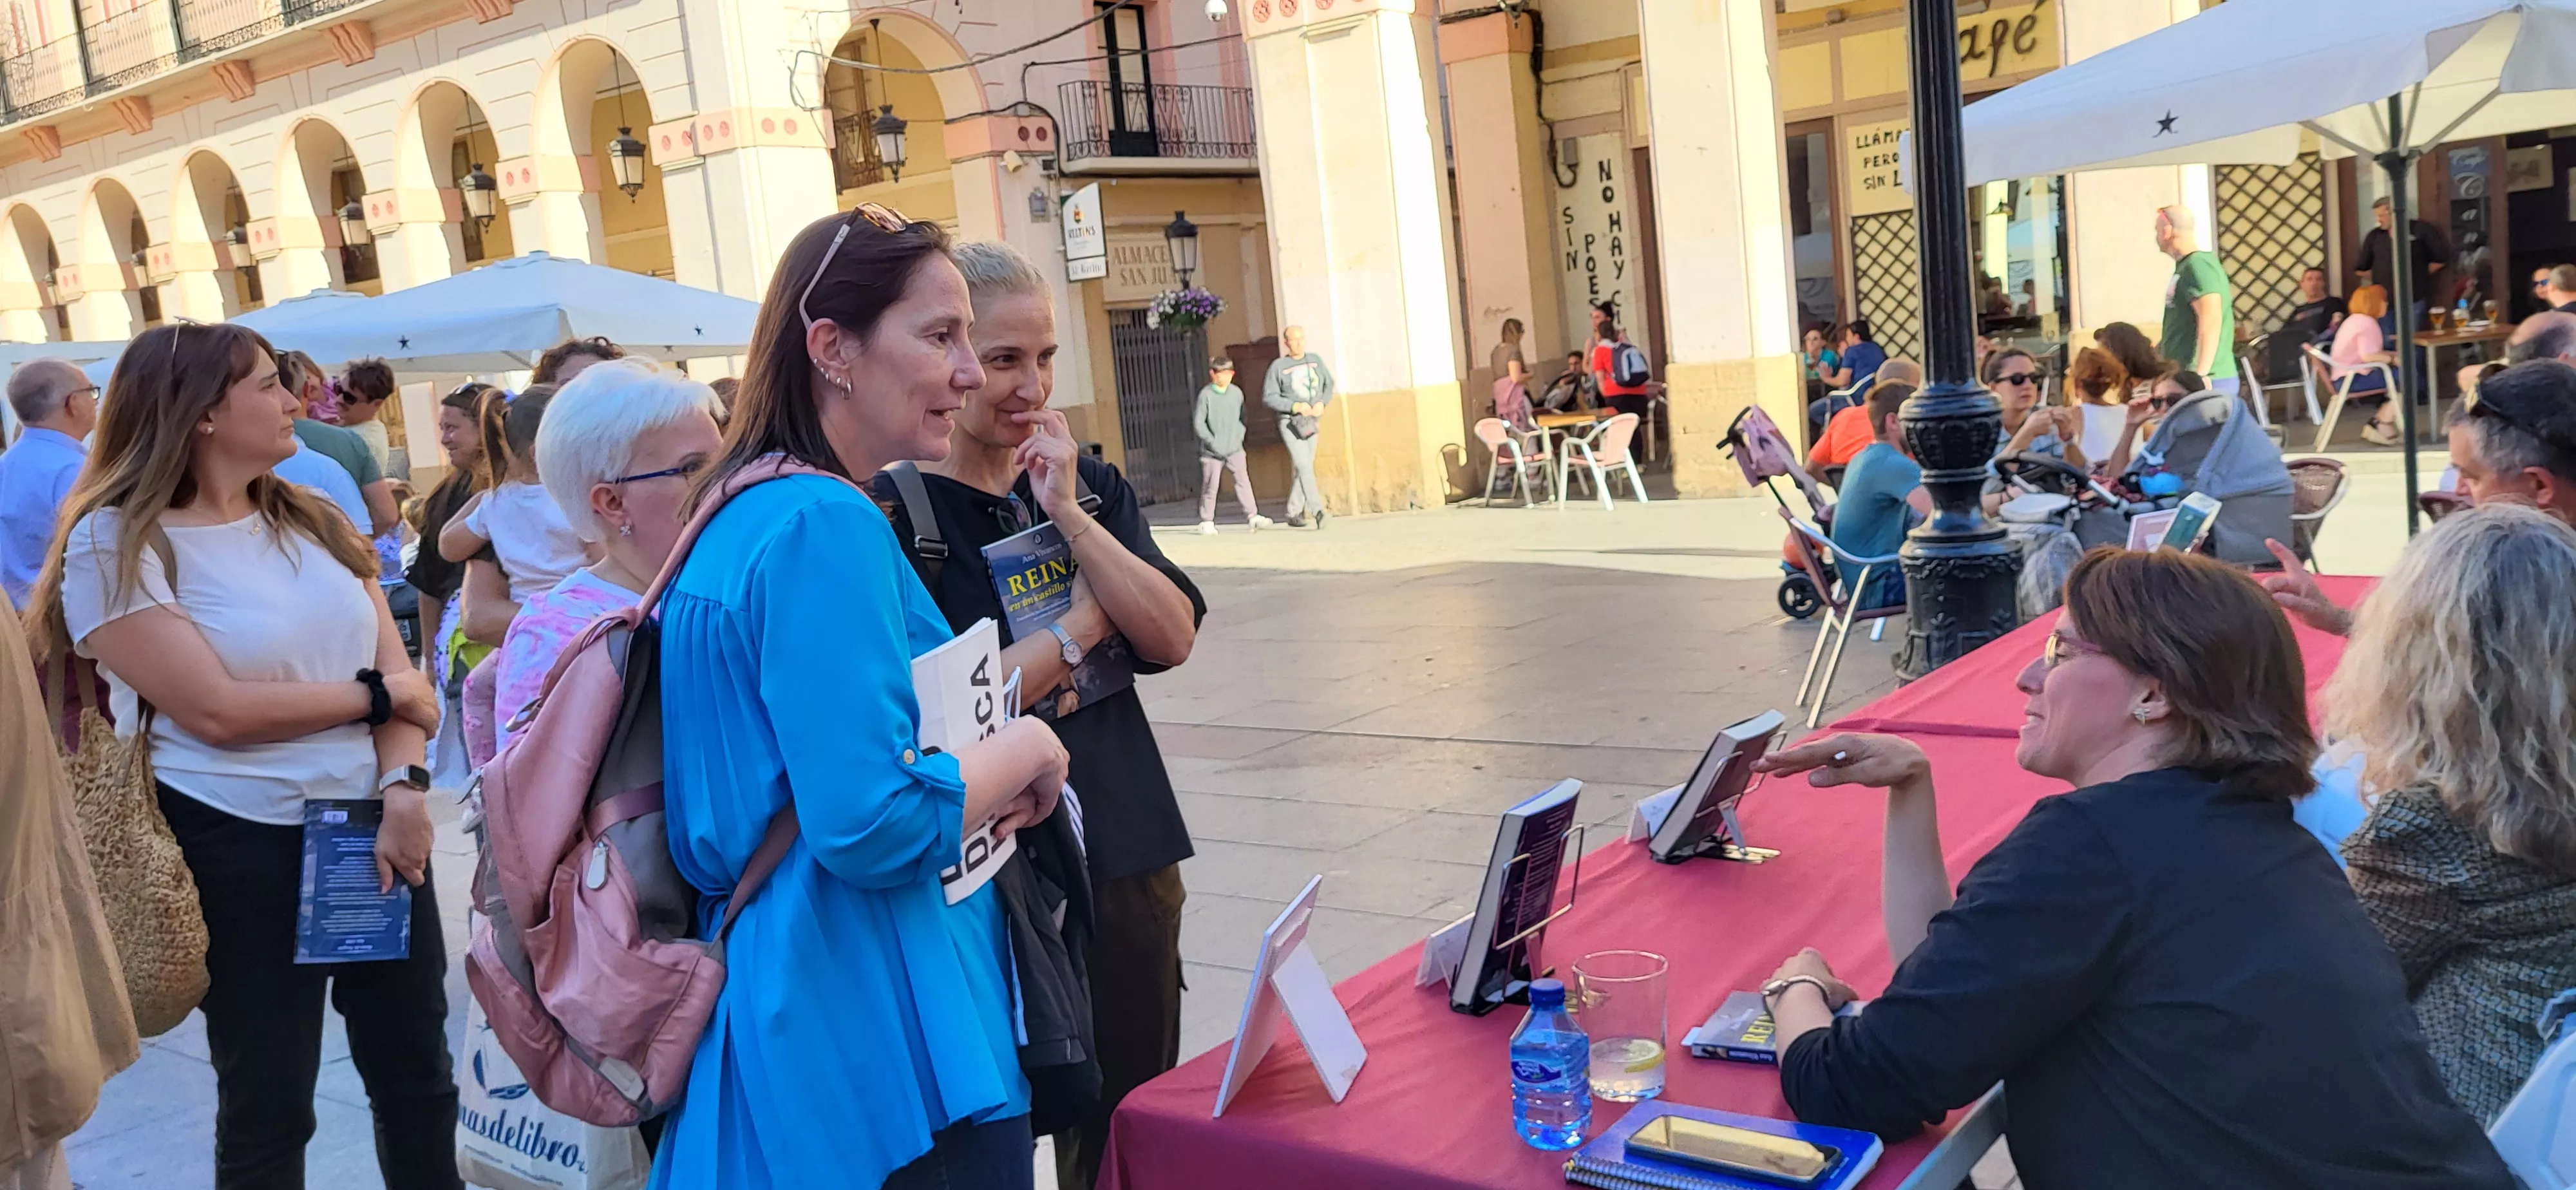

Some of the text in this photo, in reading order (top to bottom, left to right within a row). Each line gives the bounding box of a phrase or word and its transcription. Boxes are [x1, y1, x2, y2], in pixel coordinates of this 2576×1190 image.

[1959, 0, 2048, 78] afé
[1857, 127, 1910, 149] LLÁMA
[1864, 152, 1899, 168] PERO
[1863, 175, 1886, 190] SIN
[1598, 158, 1614, 203] NO
[1608, 211, 1625, 279] HAY
[1563, 207, 1578, 272] SIN
[1113, 246, 1168, 265] ALMACE
[1121, 267, 1147, 286] SAN
[1584, 234, 1600, 308] POES
[1022, 554, 1036, 564] Ana
[1007, 552, 1079, 597] REINA
[1034, 581, 1065, 601] castillo
